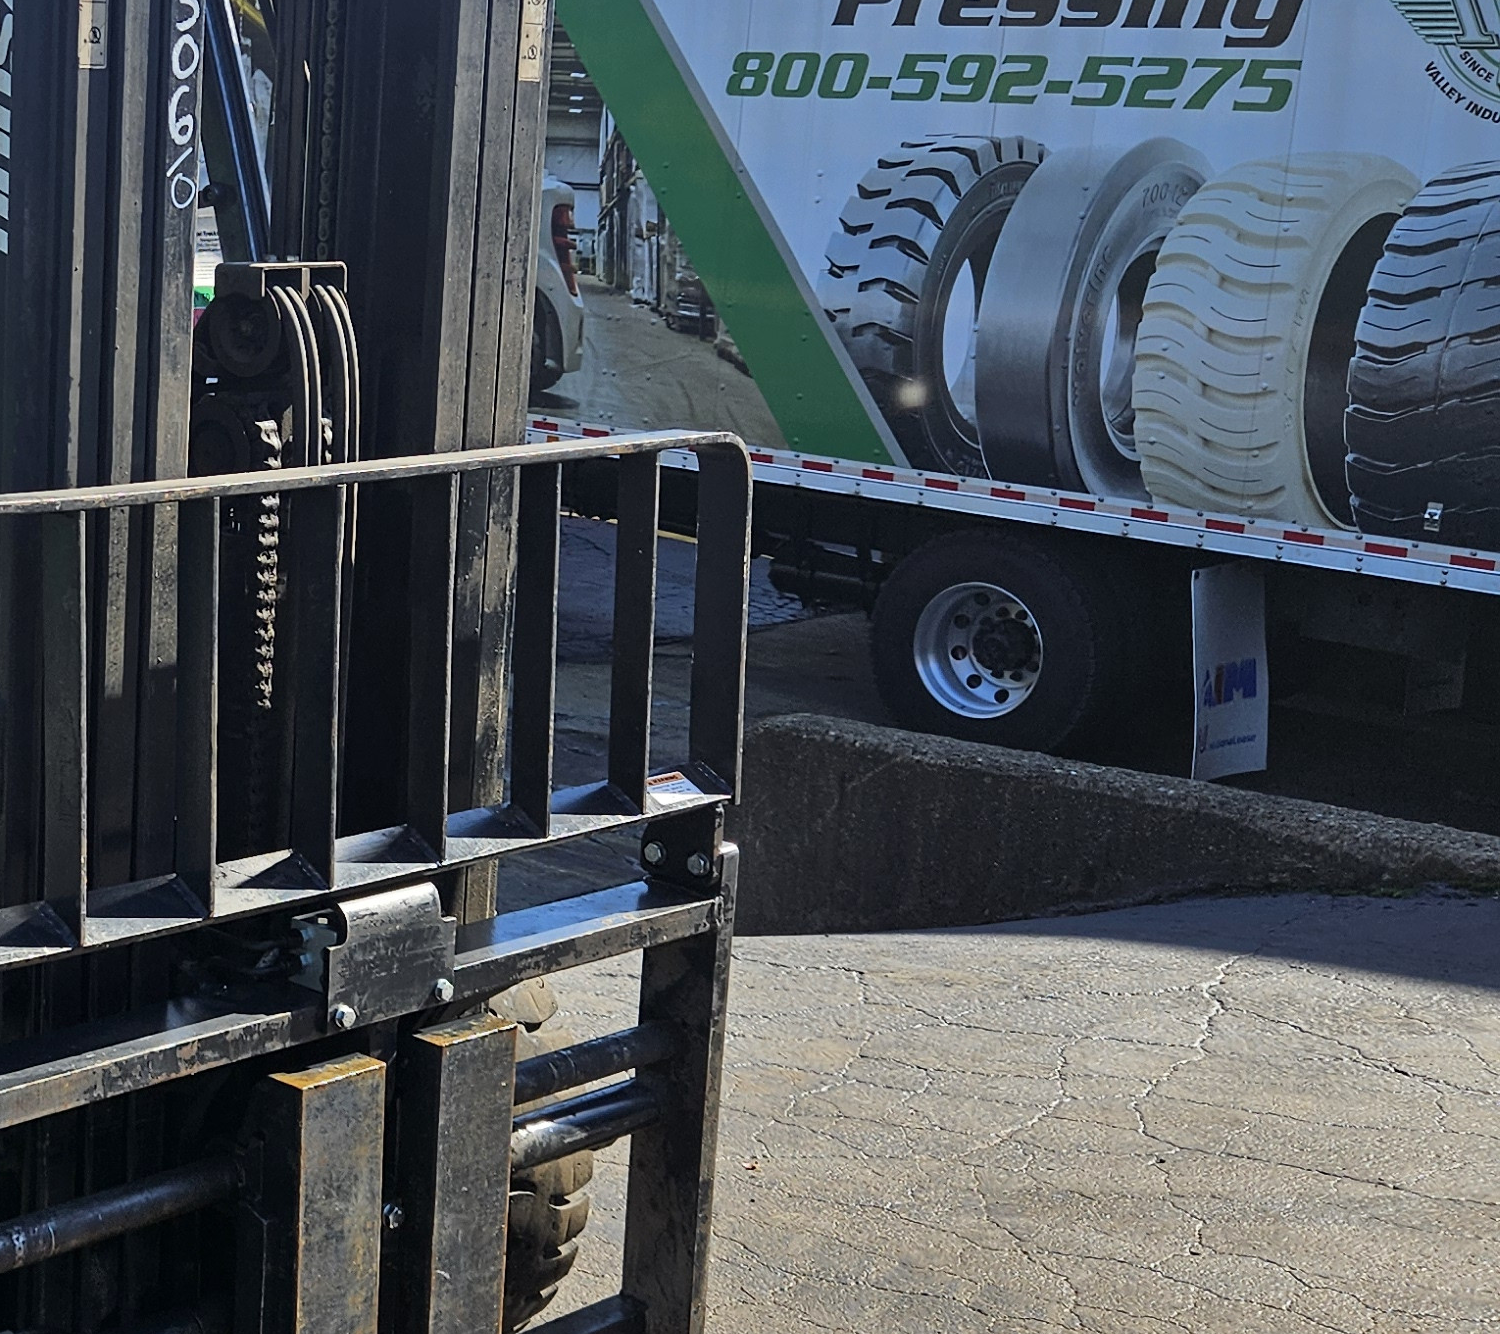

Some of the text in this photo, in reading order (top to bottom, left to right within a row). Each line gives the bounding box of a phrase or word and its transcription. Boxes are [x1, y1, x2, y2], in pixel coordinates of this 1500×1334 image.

[725, 51, 1303, 113] 800-592-5275
[1423, 60, 1467, 105] VALLEY
[1459, 50, 1495, 84] SINCE
